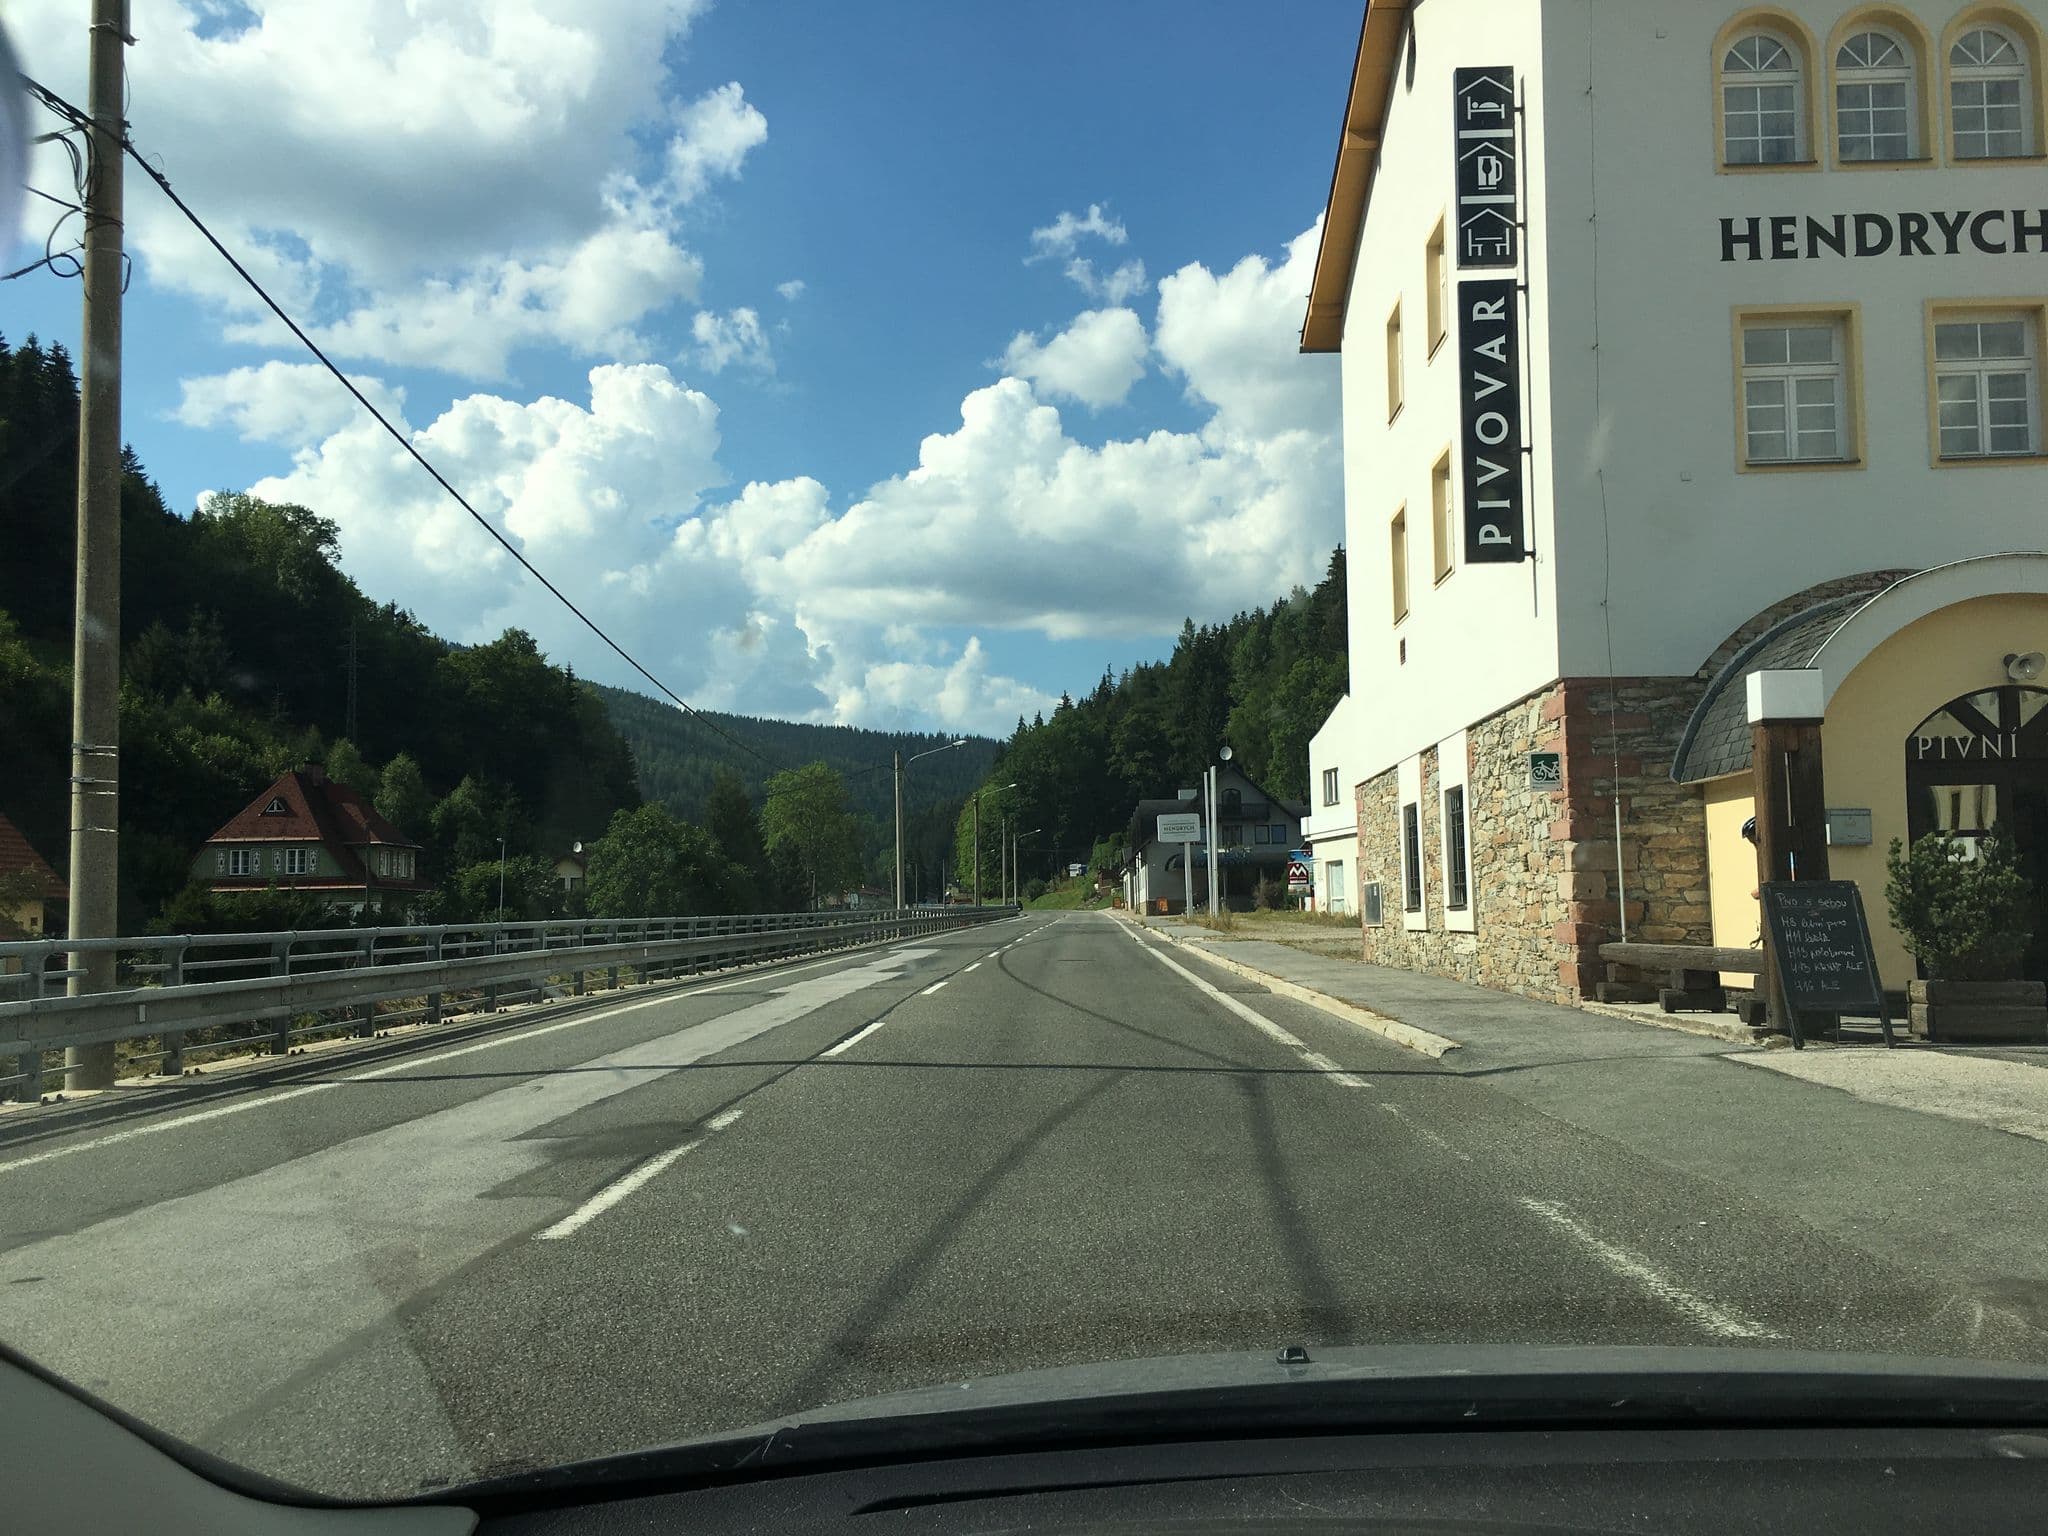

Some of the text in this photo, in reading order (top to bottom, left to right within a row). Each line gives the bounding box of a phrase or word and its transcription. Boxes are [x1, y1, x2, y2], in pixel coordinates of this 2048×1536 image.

[1718, 209, 2048, 262] HENDRYCH
[1472, 296, 1512, 546] PIVOVAR
[1918, 726, 2017, 760] PIVNÍ
